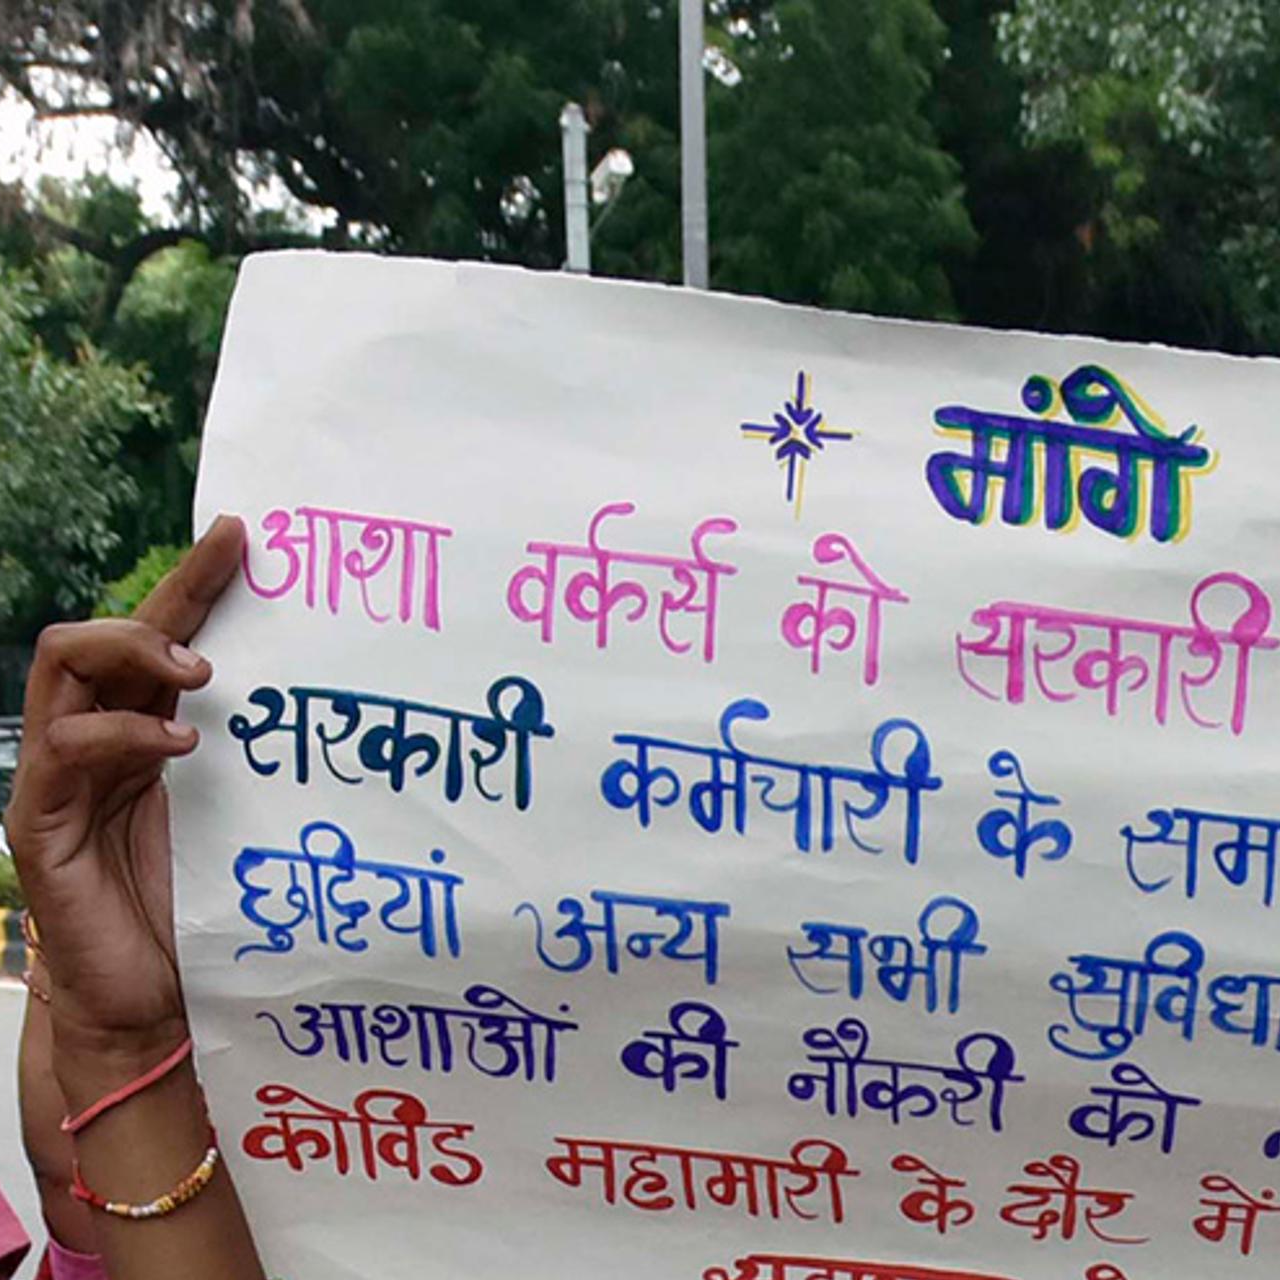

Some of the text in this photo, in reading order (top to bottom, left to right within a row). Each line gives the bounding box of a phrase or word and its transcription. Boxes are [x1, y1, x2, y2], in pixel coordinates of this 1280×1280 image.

[243, 504, 453, 633] आशा
[508, 503, 737, 663] वर्कर्स
[781, 533, 909, 686] को
[956, 572, 1280, 735] सरकारी
[228, 675, 556, 812] सरकारी
[600, 698, 944, 866] कर्मचारी
[976, 750, 1073, 879] के
[514, 890, 731, 986] अन्य
[786, 895, 988, 1015] सभी
[620, 1001, 740, 1102] की
[787, 1017, 1026, 1133] नौकरी
[1068, 1062, 1202, 1155] को
[242, 1084, 484, 1187] कोविड
[545, 1137, 861, 1224] महामारी
[890, 1153, 976, 1235] के
[999, 1153, 1148, 1244] दौर
